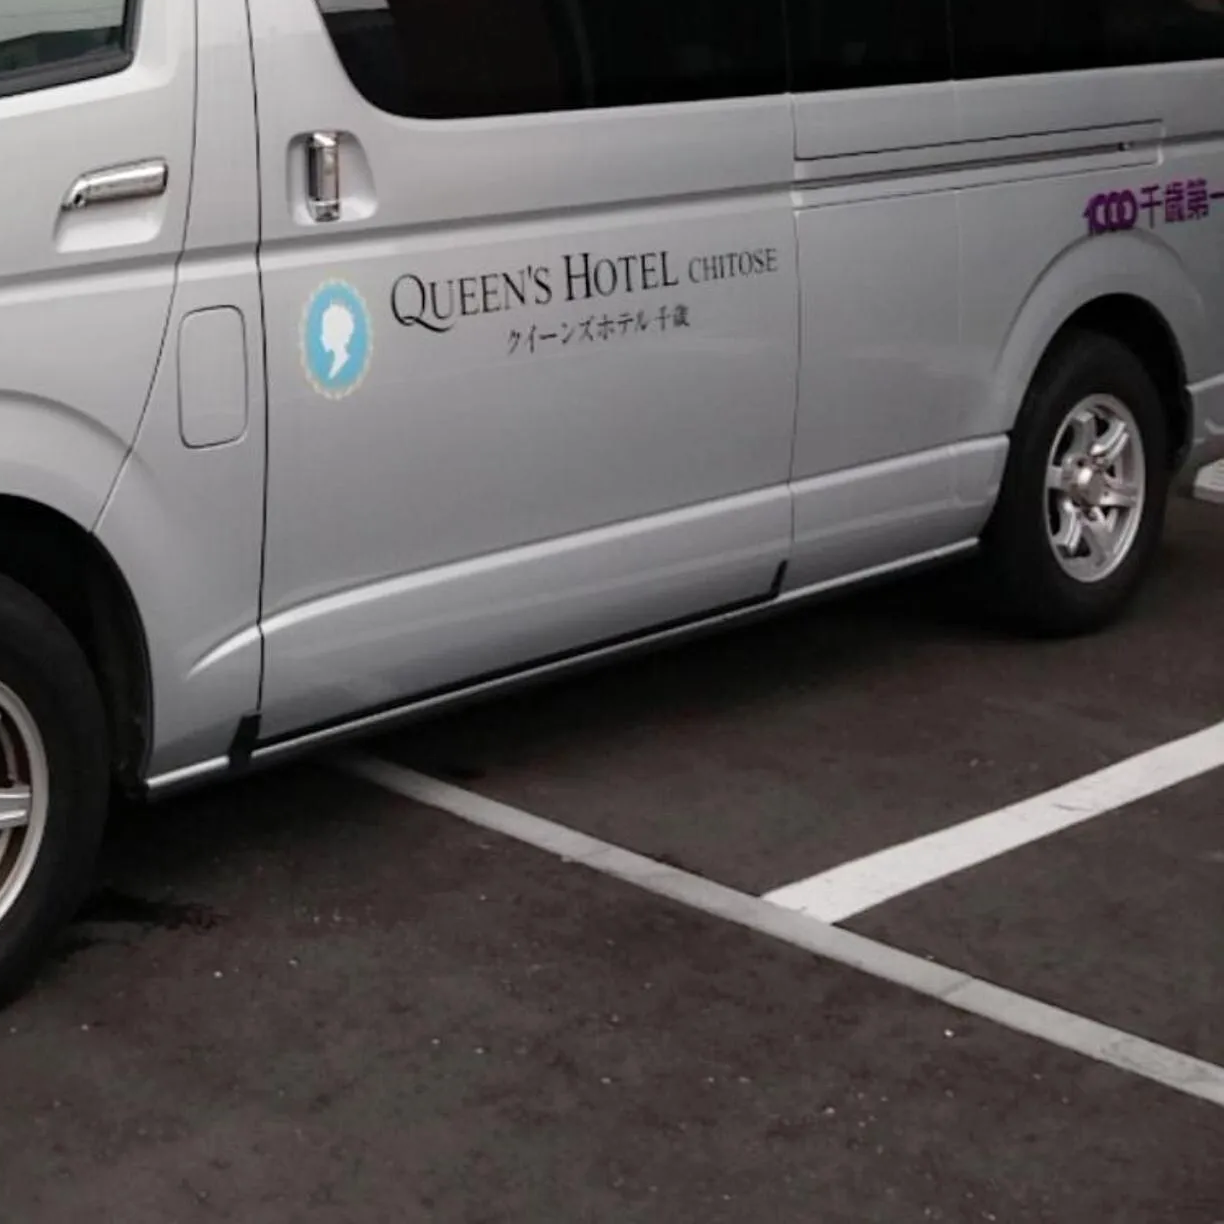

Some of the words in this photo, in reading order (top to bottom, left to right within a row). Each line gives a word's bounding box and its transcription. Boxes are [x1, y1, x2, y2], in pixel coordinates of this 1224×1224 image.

[389, 263, 553, 334] QUEEN'S
[563, 250, 680, 303] HOTEL
[688, 248, 780, 284] CHITOSE
